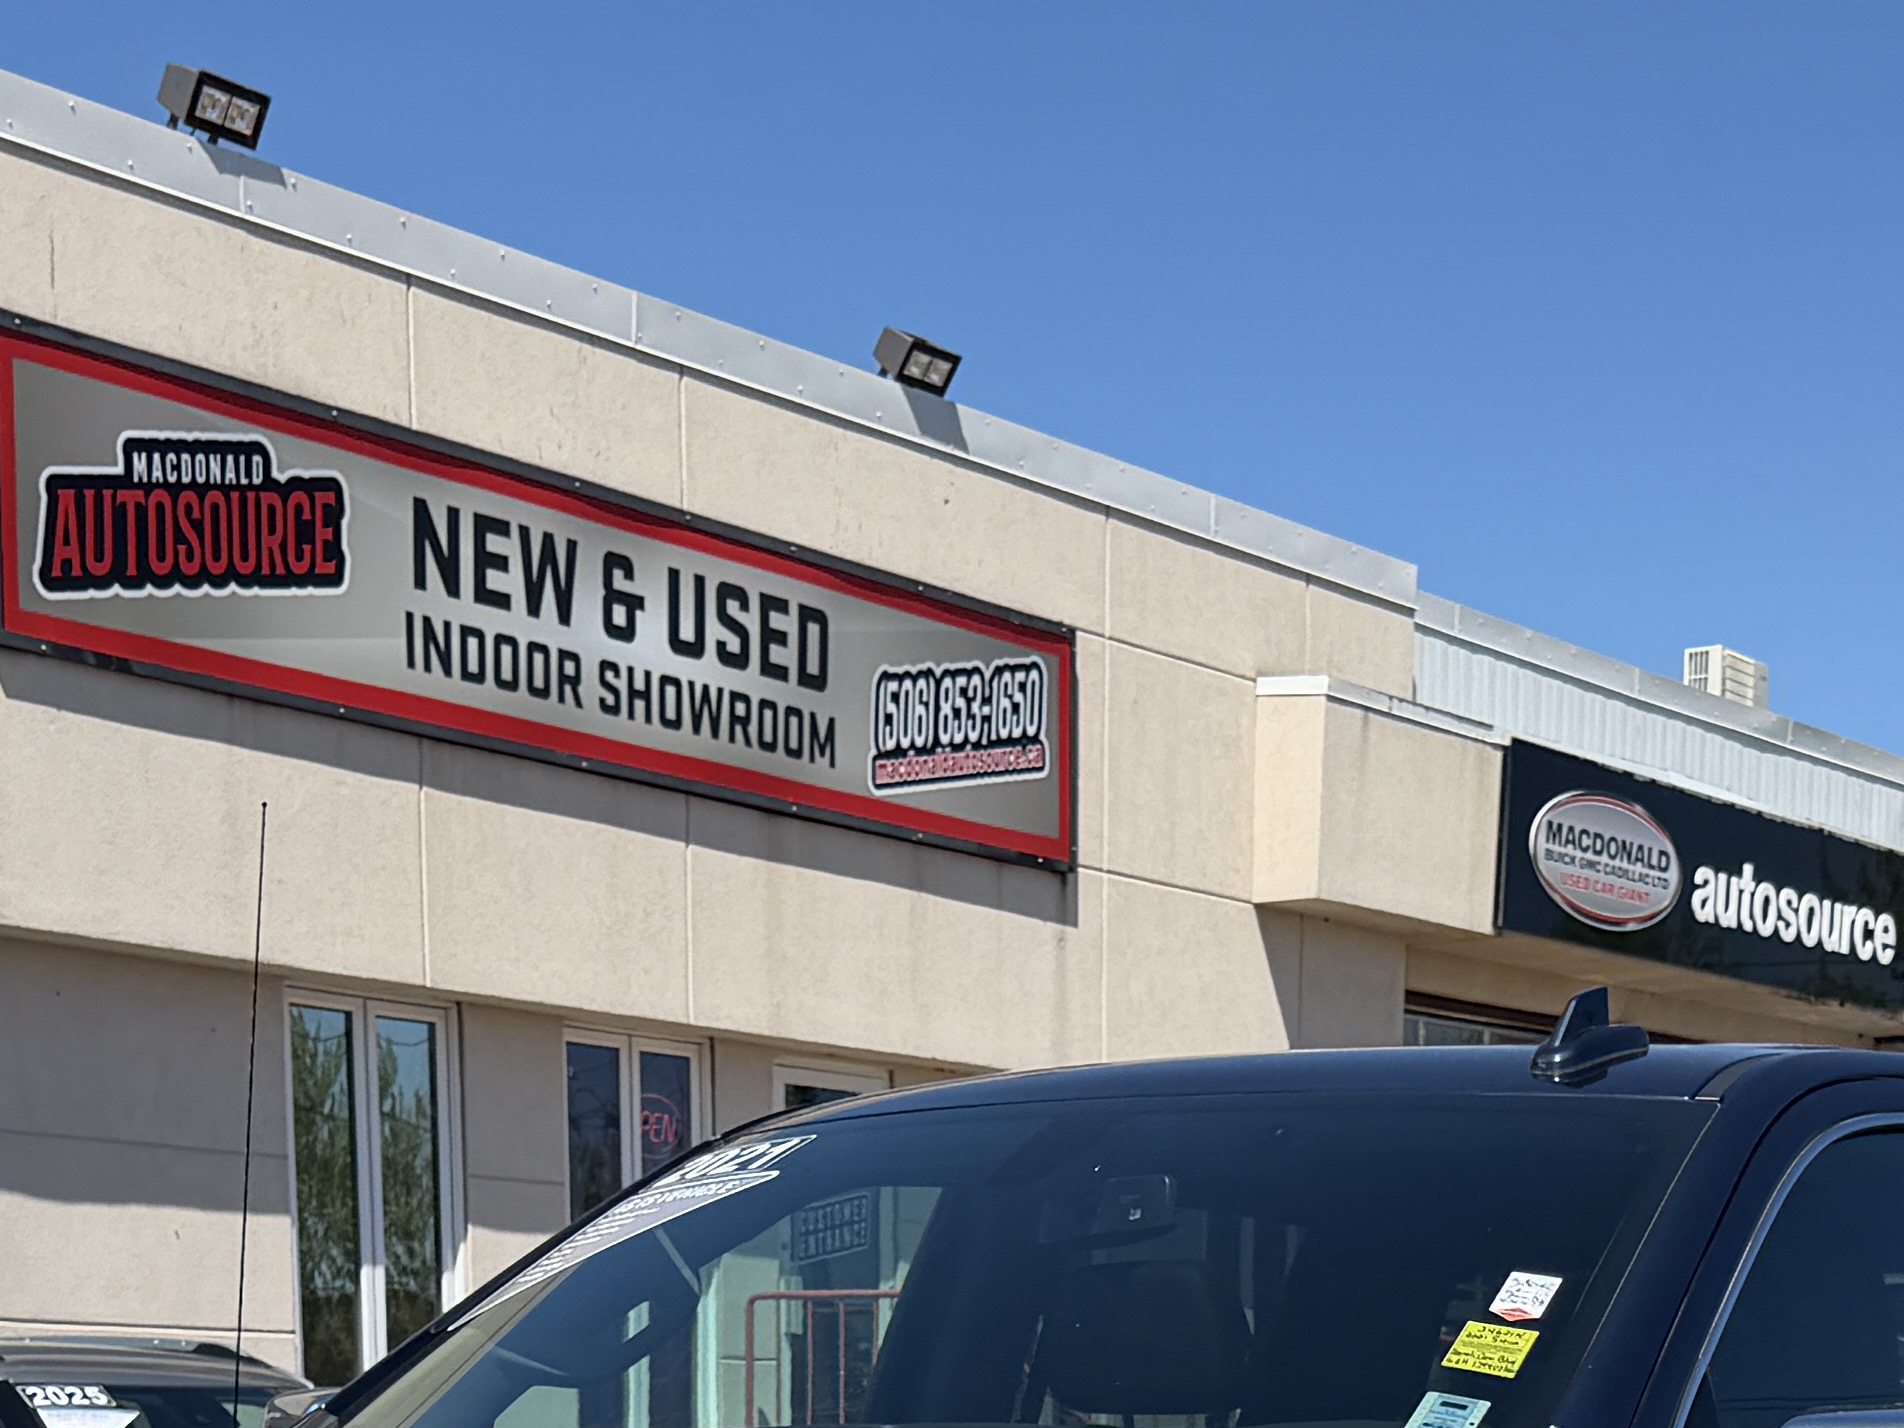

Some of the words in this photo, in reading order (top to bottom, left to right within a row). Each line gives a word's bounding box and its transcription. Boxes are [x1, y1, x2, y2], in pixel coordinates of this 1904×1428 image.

[132, 452, 263, 485] MACDONALD
[51, 488, 337, 577] AUTOSOURCE
[413, 496, 578, 627] NEW
[602, 551, 645, 643] &
[667, 567, 829, 692] USED
[405, 611, 583, 709] INDOOR
[598, 659, 836, 768] SHOWROOM
[878, 675, 936, 752] (506)
[938, 668, 1040, 746] 853-1650
[1545, 819, 1671, 873] MACDONALD
[1692, 862, 1896, 966] autosource
[641, 1110, 678, 1145] PEN
[652, 1136, 801, 1189] 2021
[25, 1385, 109, 1406] 2025
